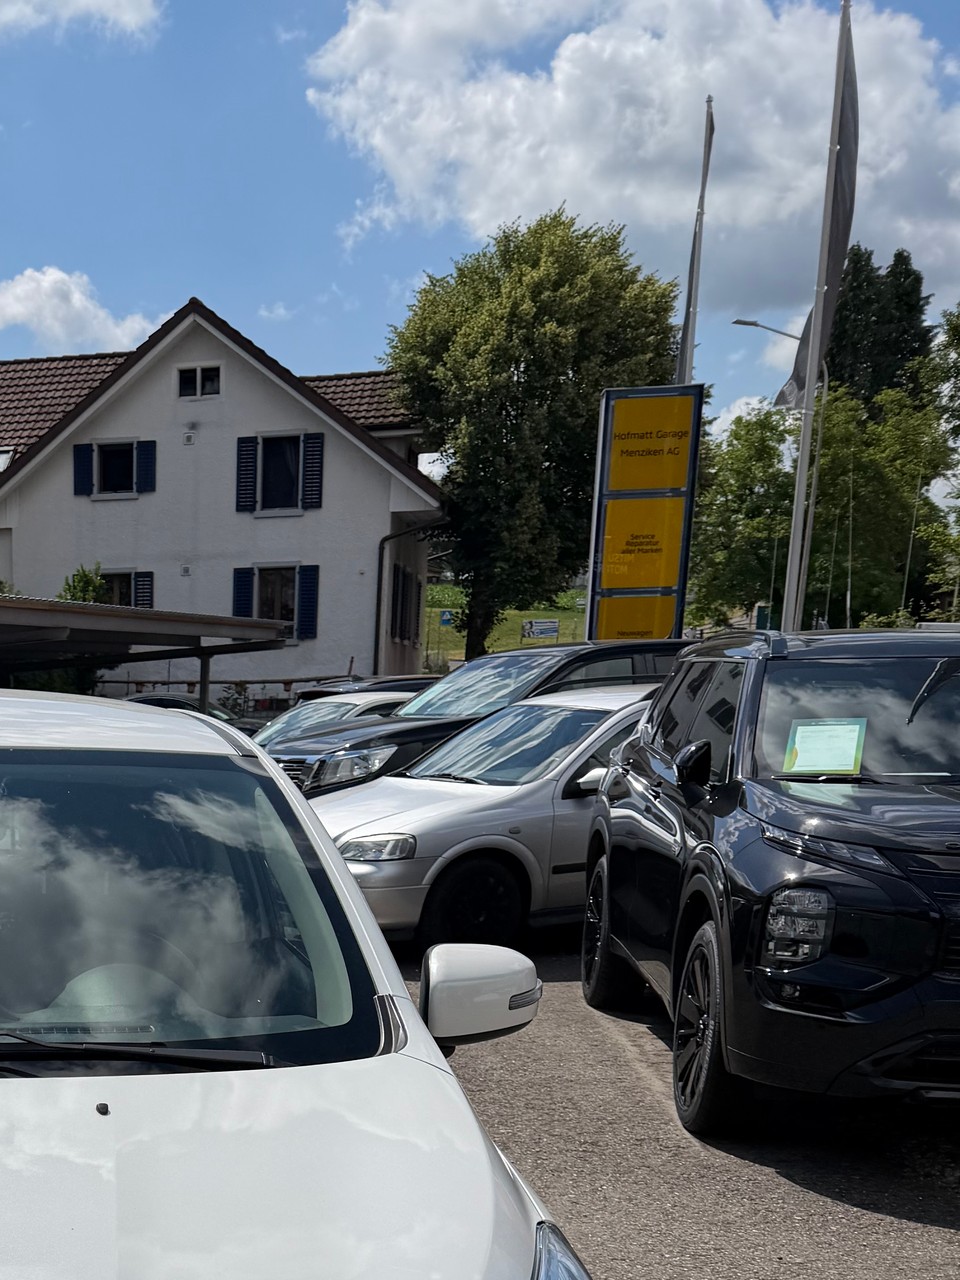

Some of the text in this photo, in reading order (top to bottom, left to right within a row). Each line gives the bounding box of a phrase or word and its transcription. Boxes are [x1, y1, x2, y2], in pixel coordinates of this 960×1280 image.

[613, 430, 689, 441] Hofmatt Garage
[620, 447, 680, 457] Menziken AG
